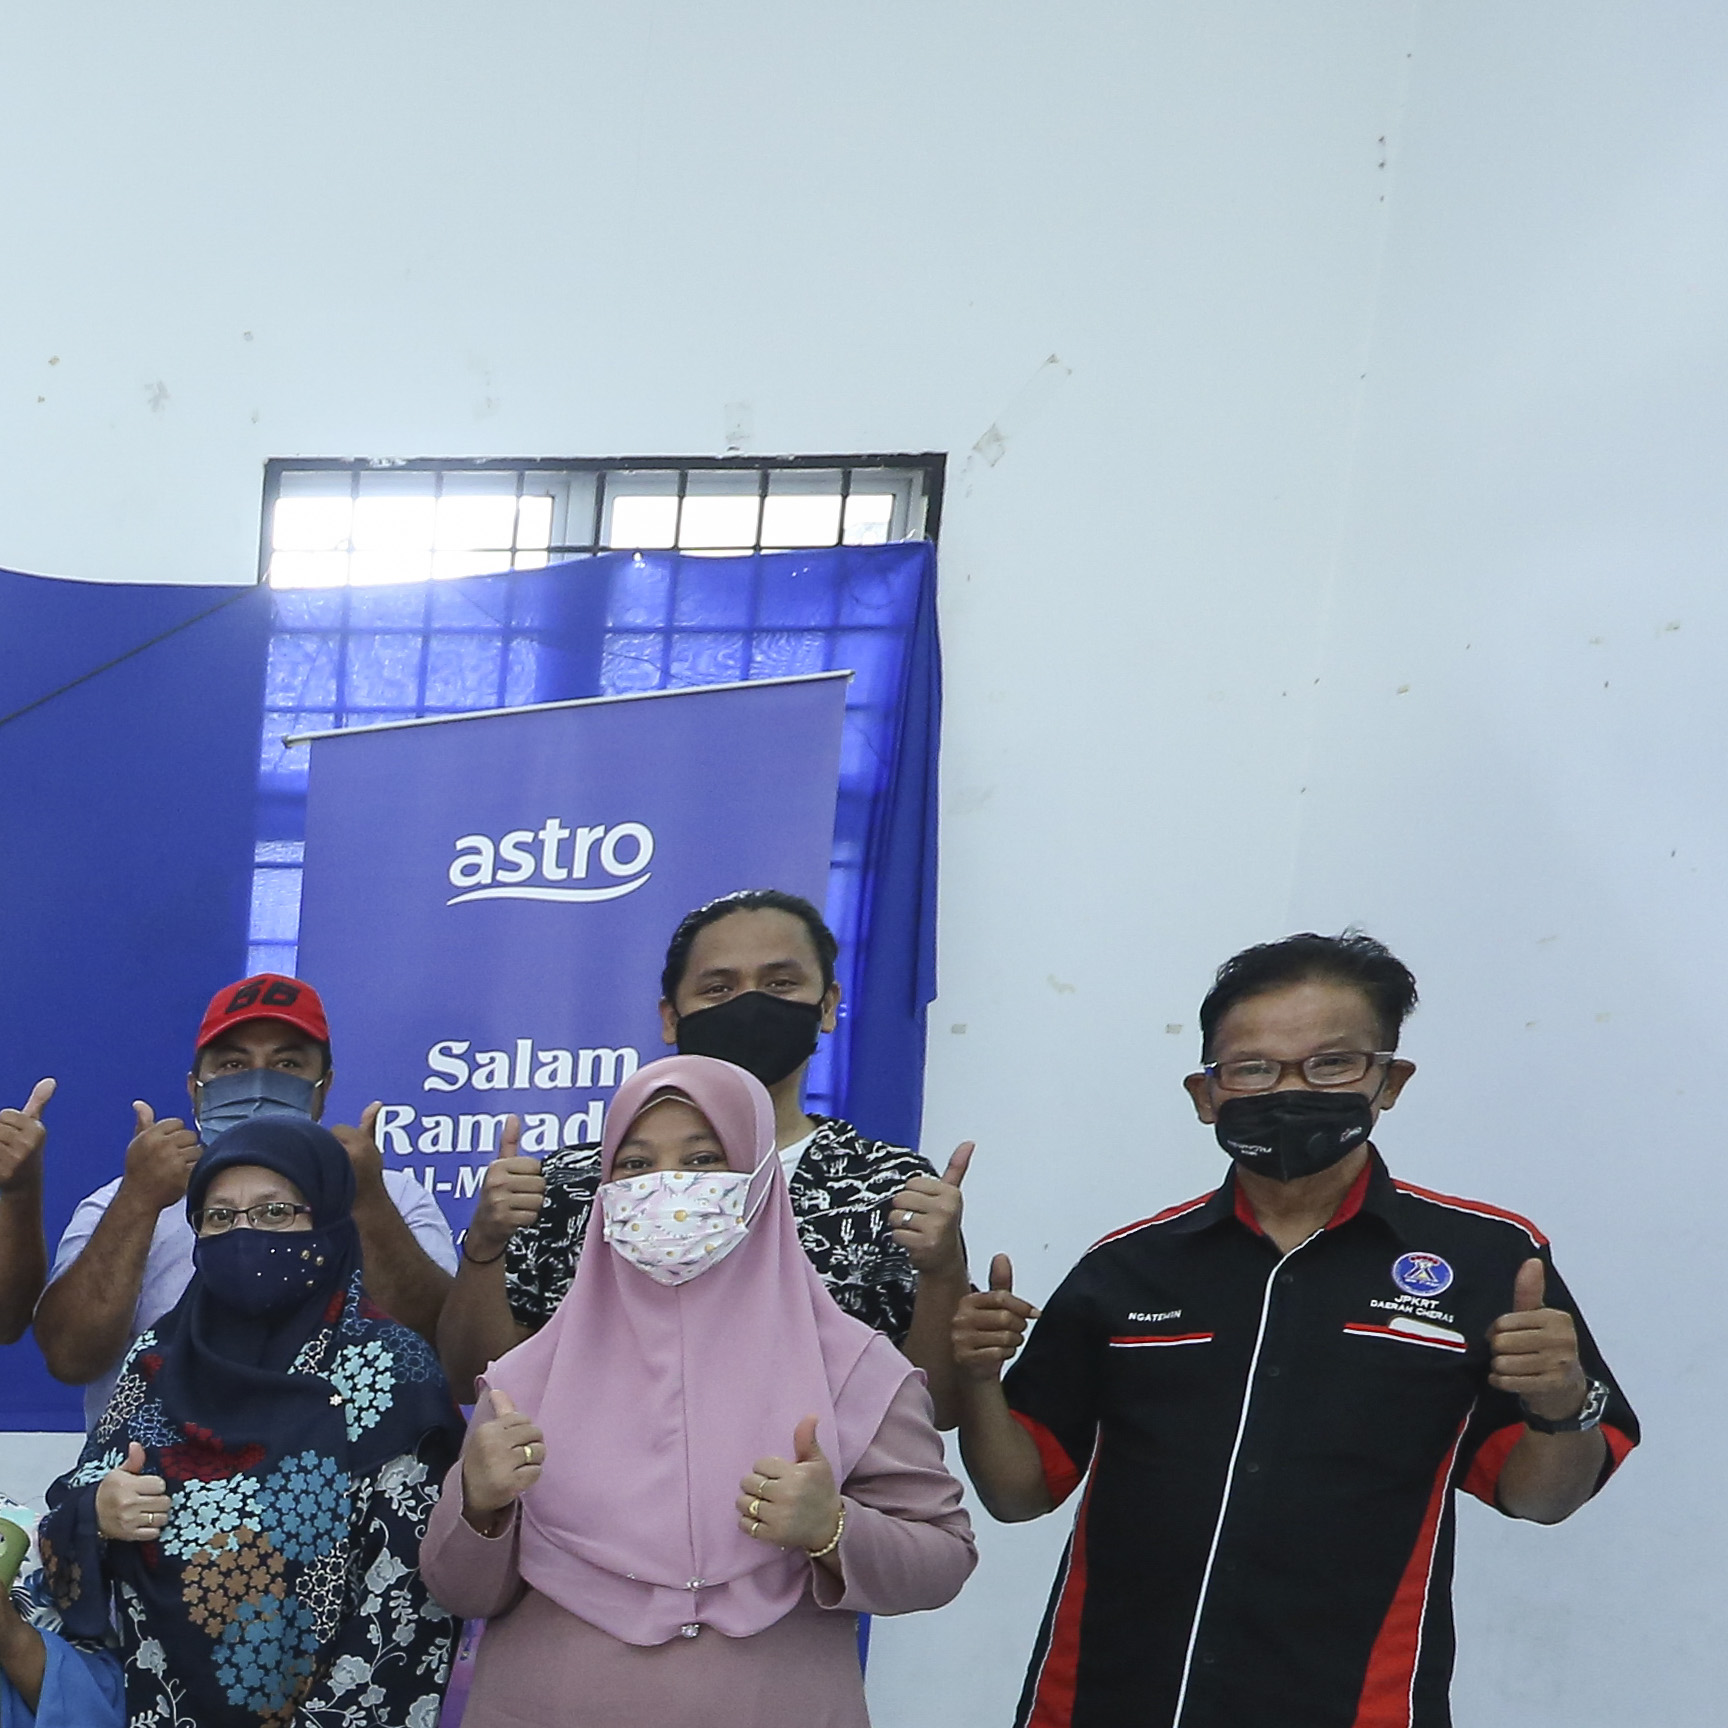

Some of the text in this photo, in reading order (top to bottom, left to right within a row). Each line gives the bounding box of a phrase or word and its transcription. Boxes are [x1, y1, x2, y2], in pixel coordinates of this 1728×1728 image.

[448, 818, 654, 888] astro
[423, 1037, 640, 1092] Salam
[374, 1100, 606, 1155] Ramad
